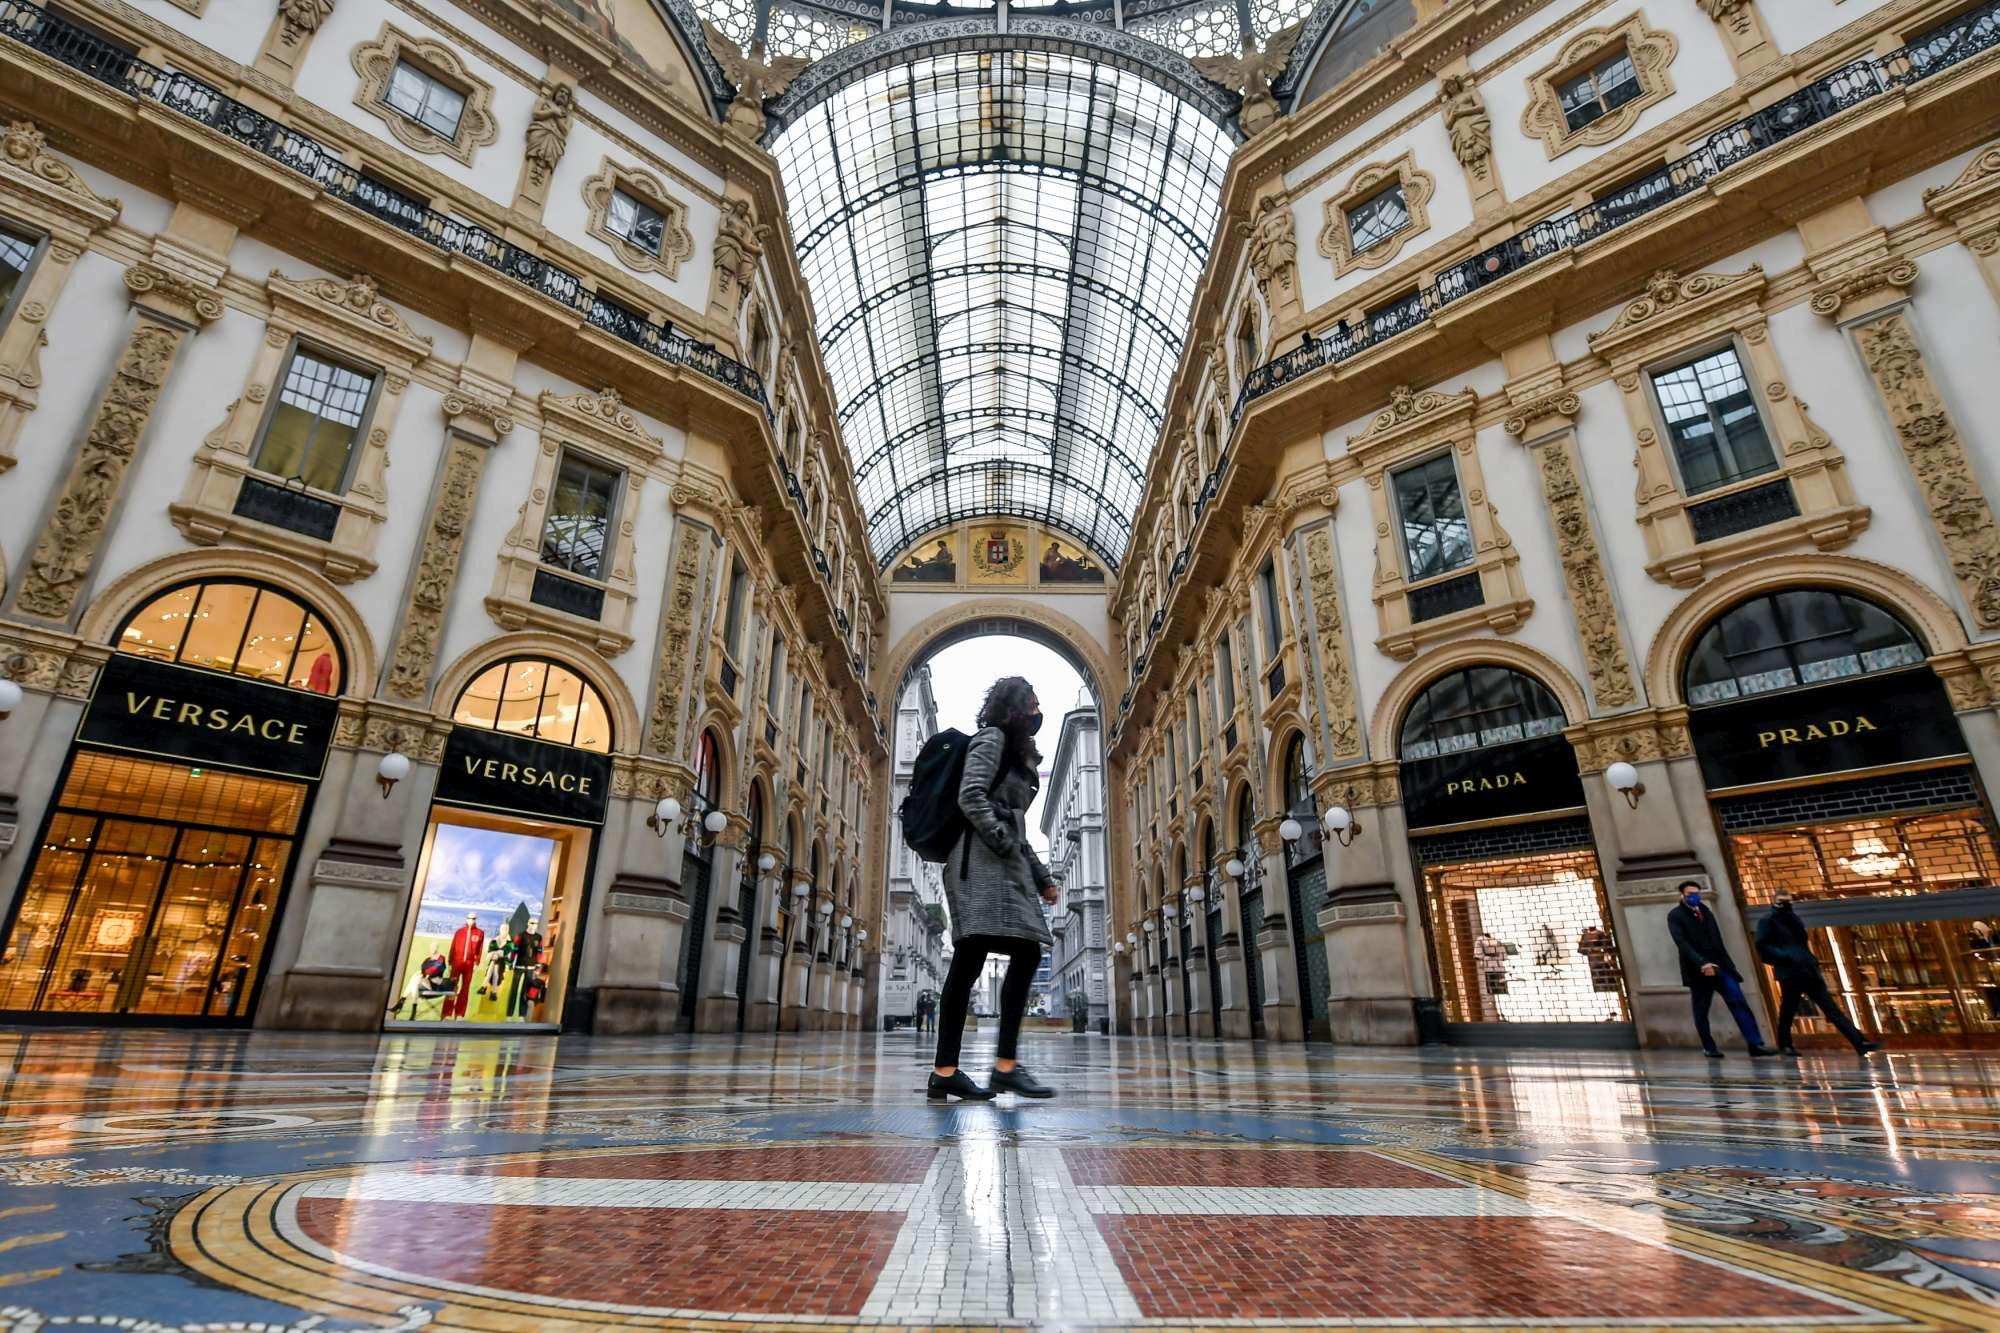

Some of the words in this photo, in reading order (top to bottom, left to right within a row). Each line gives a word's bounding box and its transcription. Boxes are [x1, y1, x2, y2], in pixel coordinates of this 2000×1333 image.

[127, 692, 308, 745] VERSACE
[1758, 716, 1878, 748] PRADA
[465, 756, 592, 795] VERSACE
[1446, 771, 1527, 795] PRADA
